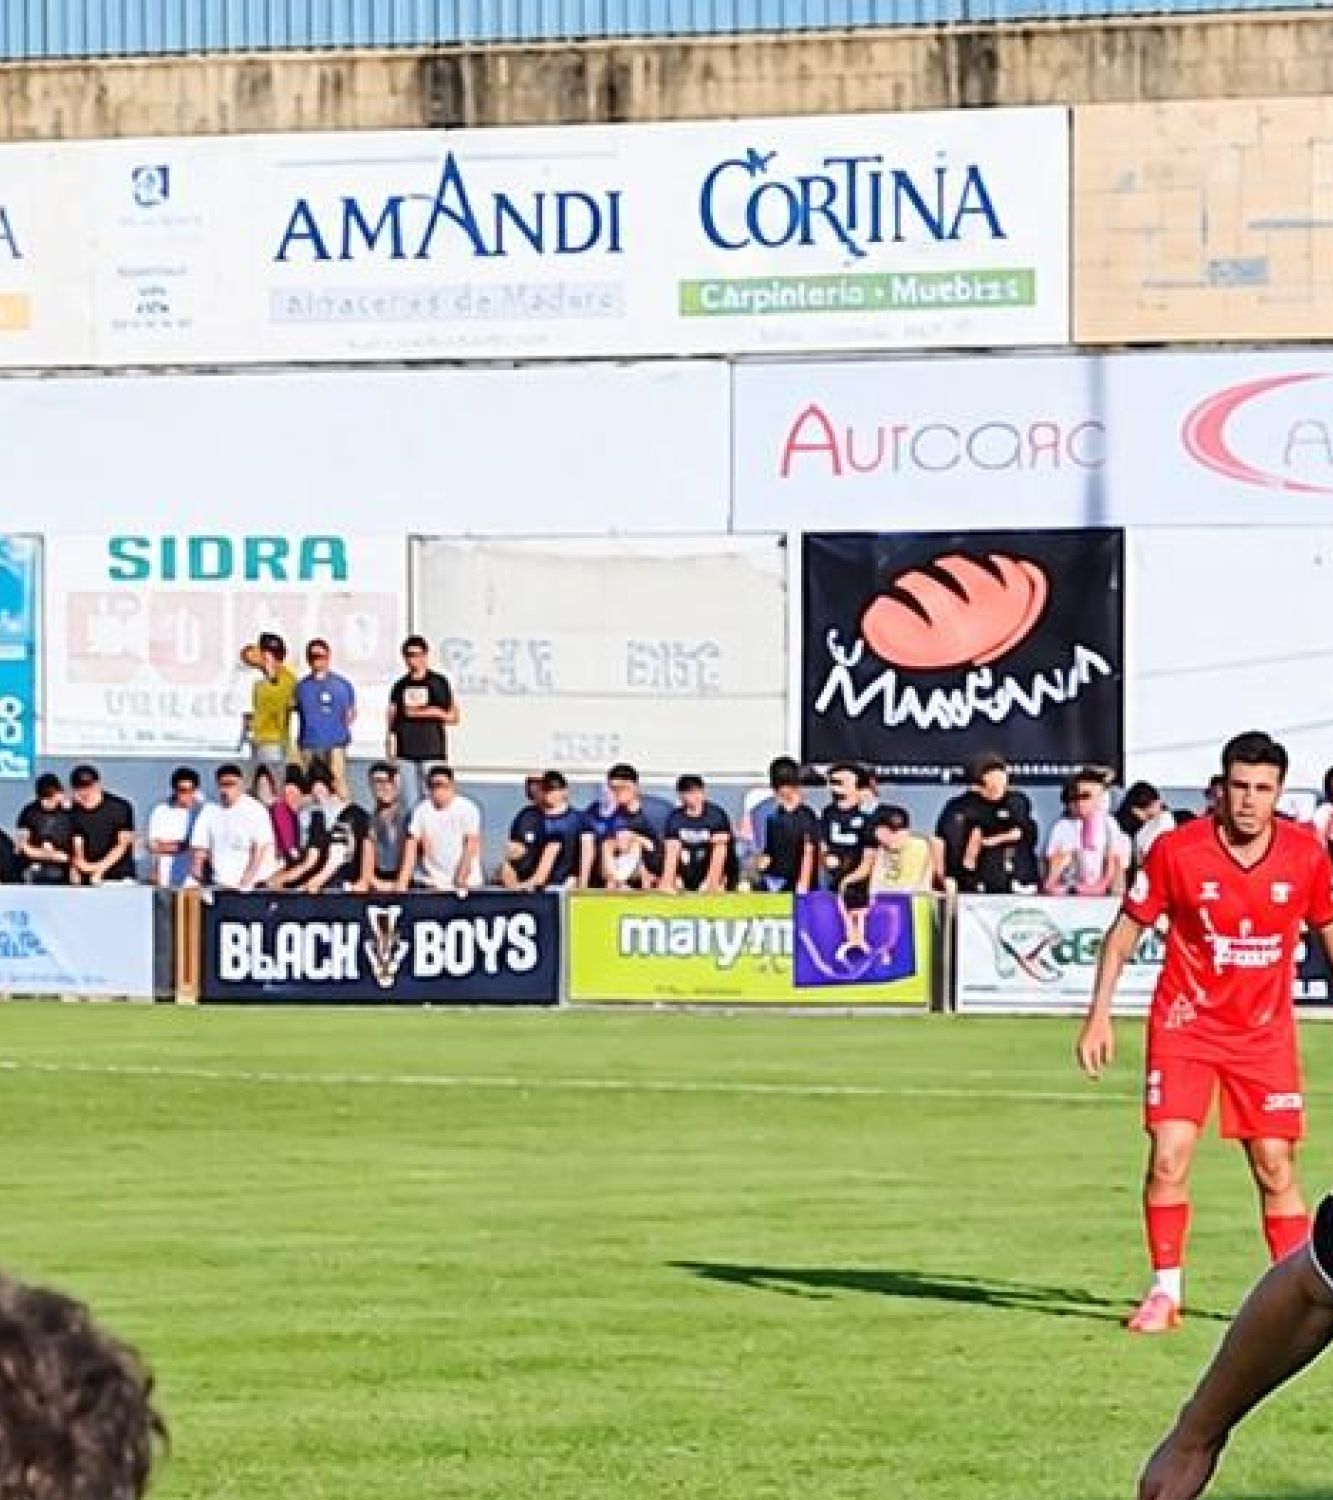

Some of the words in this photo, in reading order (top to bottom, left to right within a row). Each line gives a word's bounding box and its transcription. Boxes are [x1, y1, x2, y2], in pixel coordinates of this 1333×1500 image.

[273, 150, 624, 262] AMANDI
[700, 147, 1006, 258] CORTINA
[107, 534, 348, 582] SIDRA
[414, 912, 538, 977] BOYS
